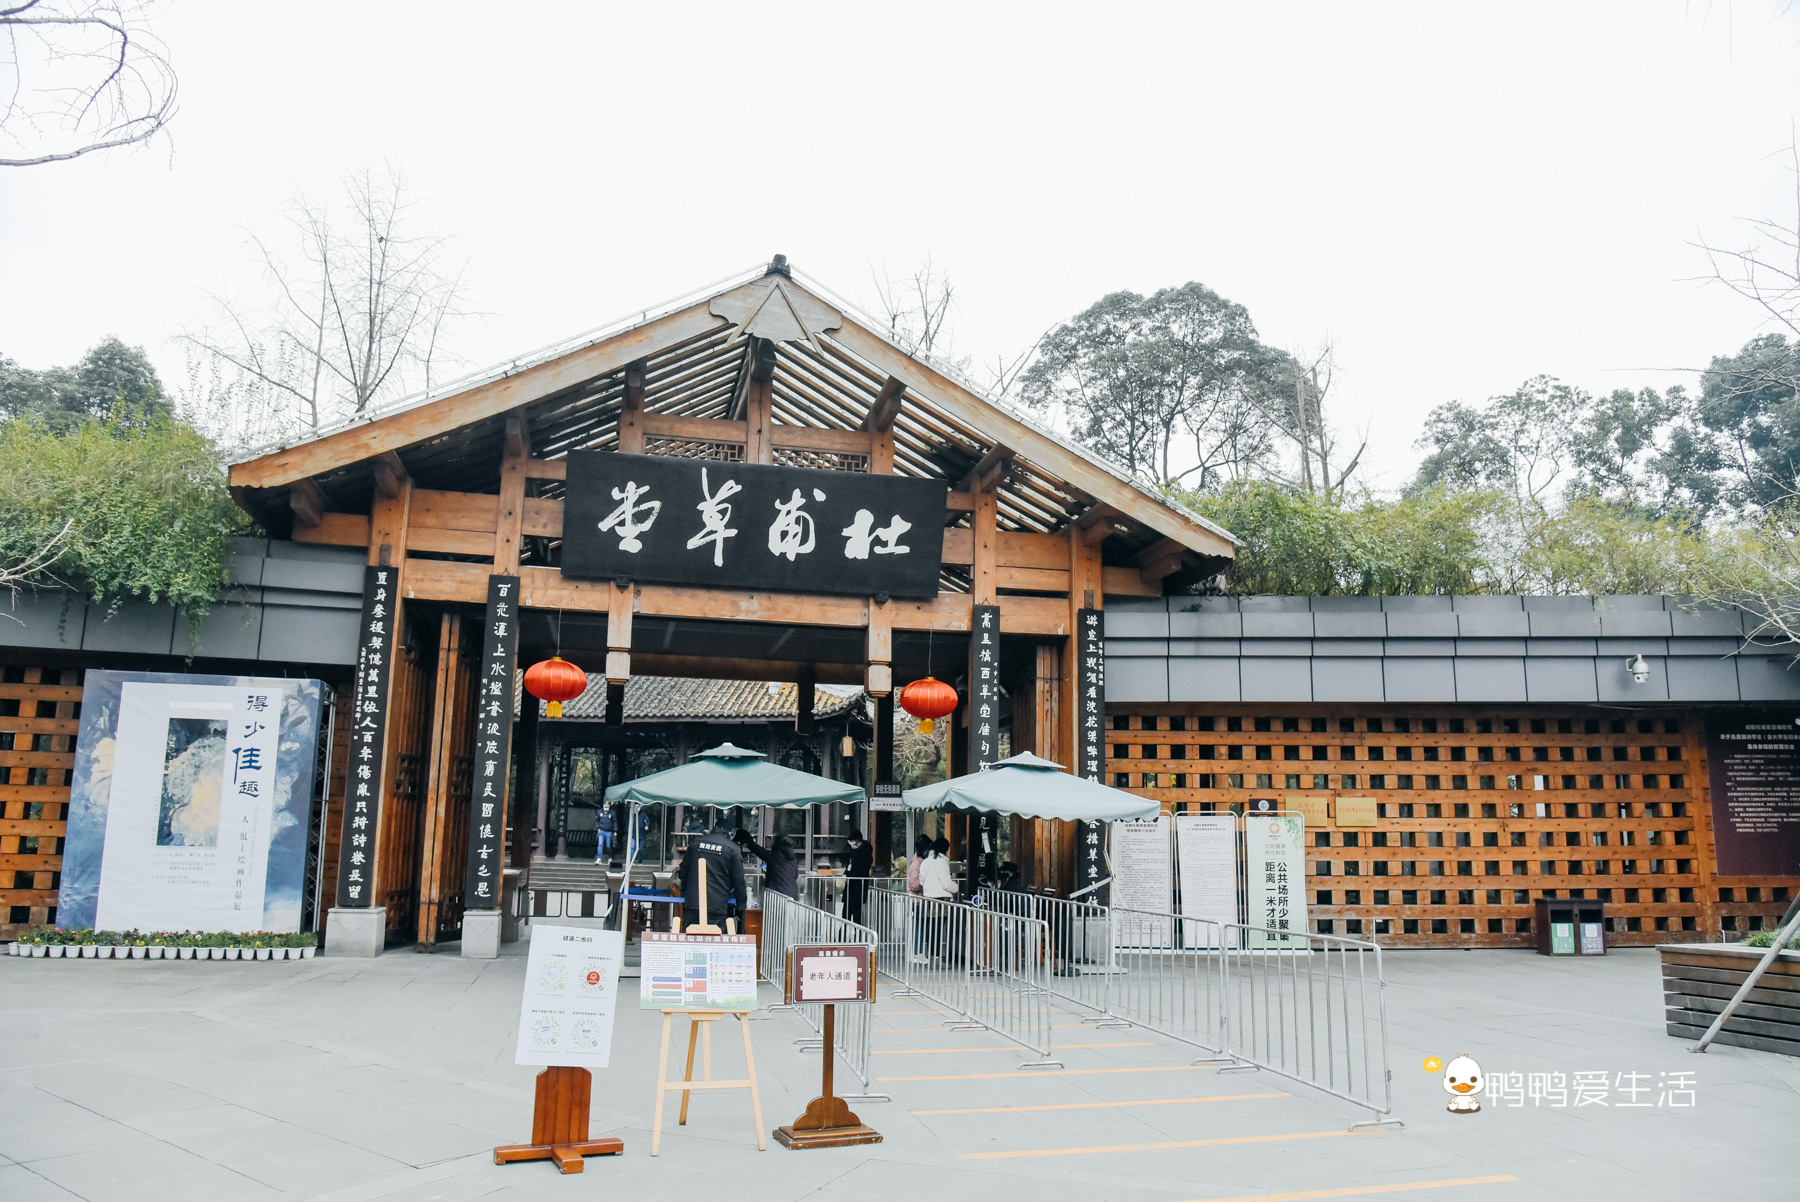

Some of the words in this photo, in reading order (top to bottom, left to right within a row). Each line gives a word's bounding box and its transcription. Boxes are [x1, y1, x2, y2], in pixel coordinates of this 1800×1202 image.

[598, 467, 912, 567] 杜甫草堂
[232, 695, 268, 798] 得少佳趣
[809, 972, 851, 981] 老年人通道
